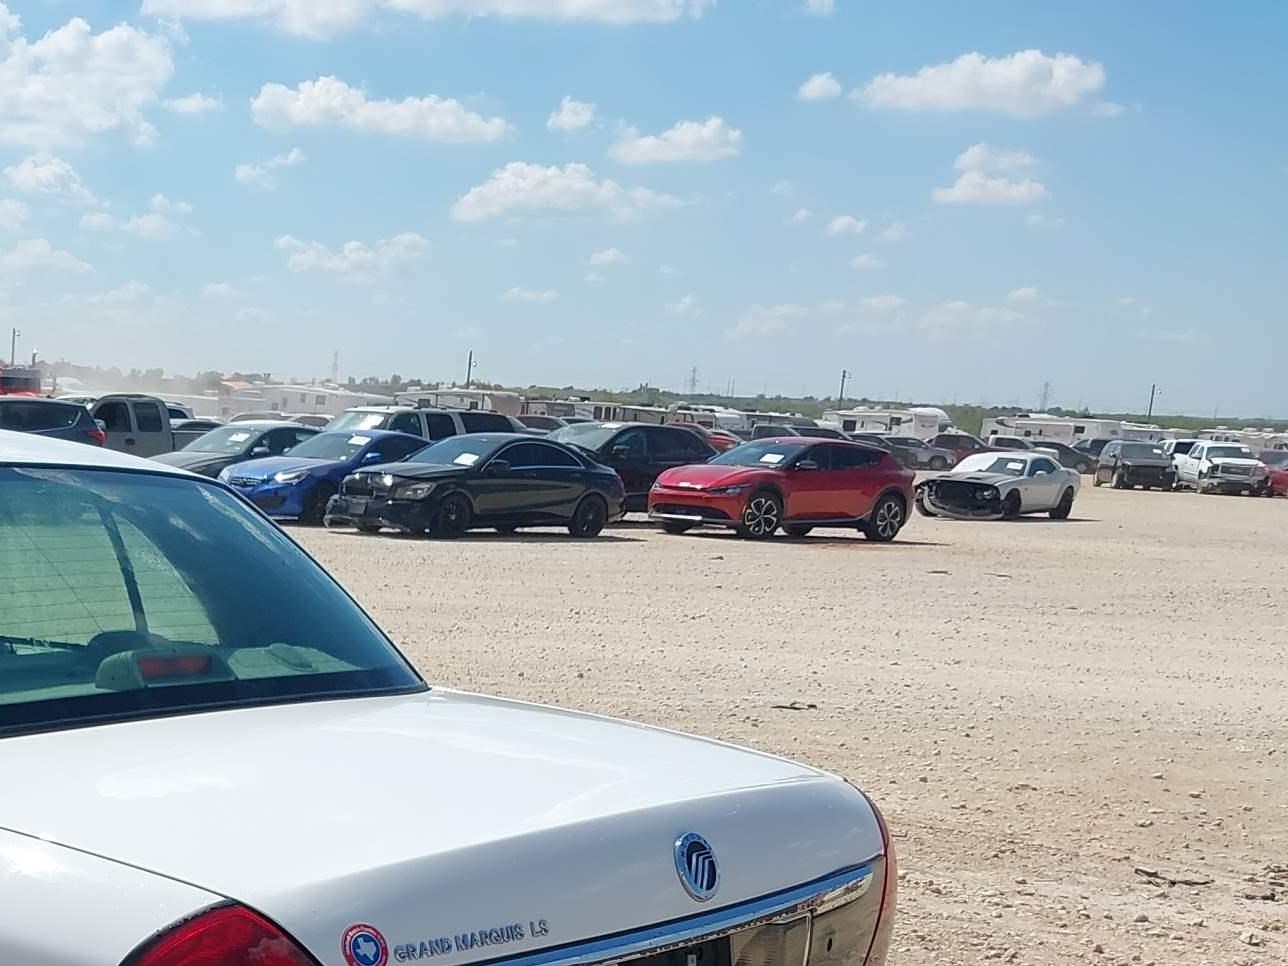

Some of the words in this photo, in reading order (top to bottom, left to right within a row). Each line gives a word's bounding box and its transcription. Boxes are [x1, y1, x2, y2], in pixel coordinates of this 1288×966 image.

[394, 938, 452, 963] GRAND
[454, 923, 525, 952] MARQUIS
[530, 920, 549, 938] LS
